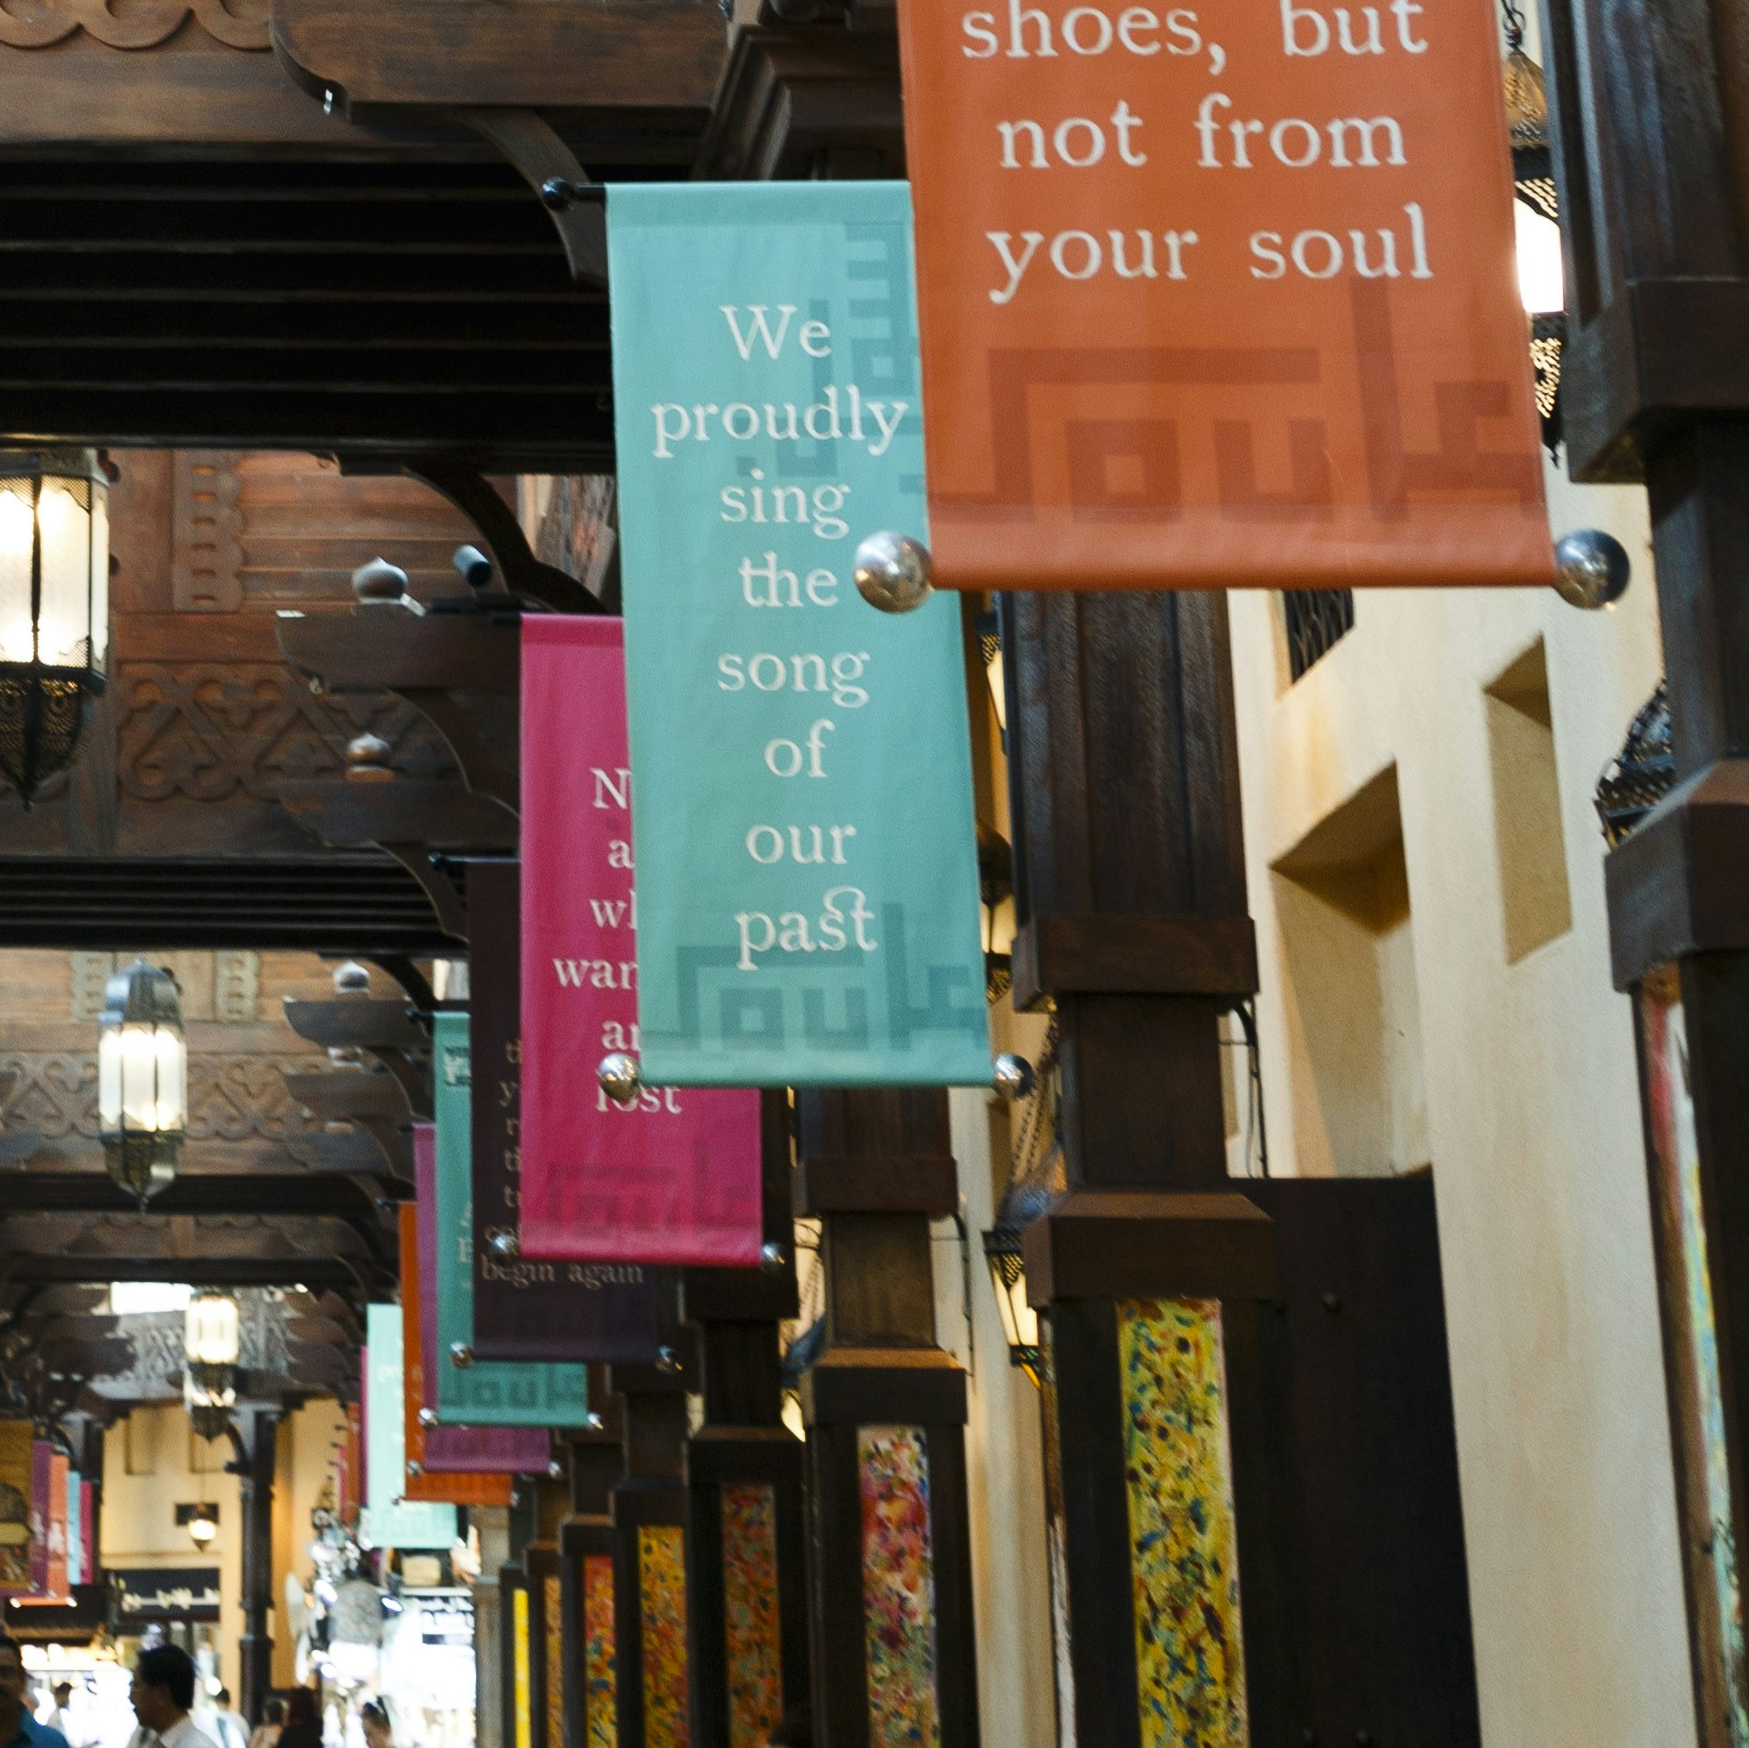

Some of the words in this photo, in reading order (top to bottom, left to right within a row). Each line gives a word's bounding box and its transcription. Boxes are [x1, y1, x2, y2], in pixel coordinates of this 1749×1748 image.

[997, 100, 1147, 168] not
[1195, 92, 1408, 168] from
[986, 230, 1198, 304] your
[1250, 202, 1433, 280] soul
[718, 303, 832, 361] We
[650, 383, 908, 459] proudly
[720, 467, 851, 540] sing
[737, 550, 839, 608] the
[717, 651, 871, 709] song
[764, 718, 836, 778] of
[745, 824, 857, 865] our
[734, 886, 877, 971] past
